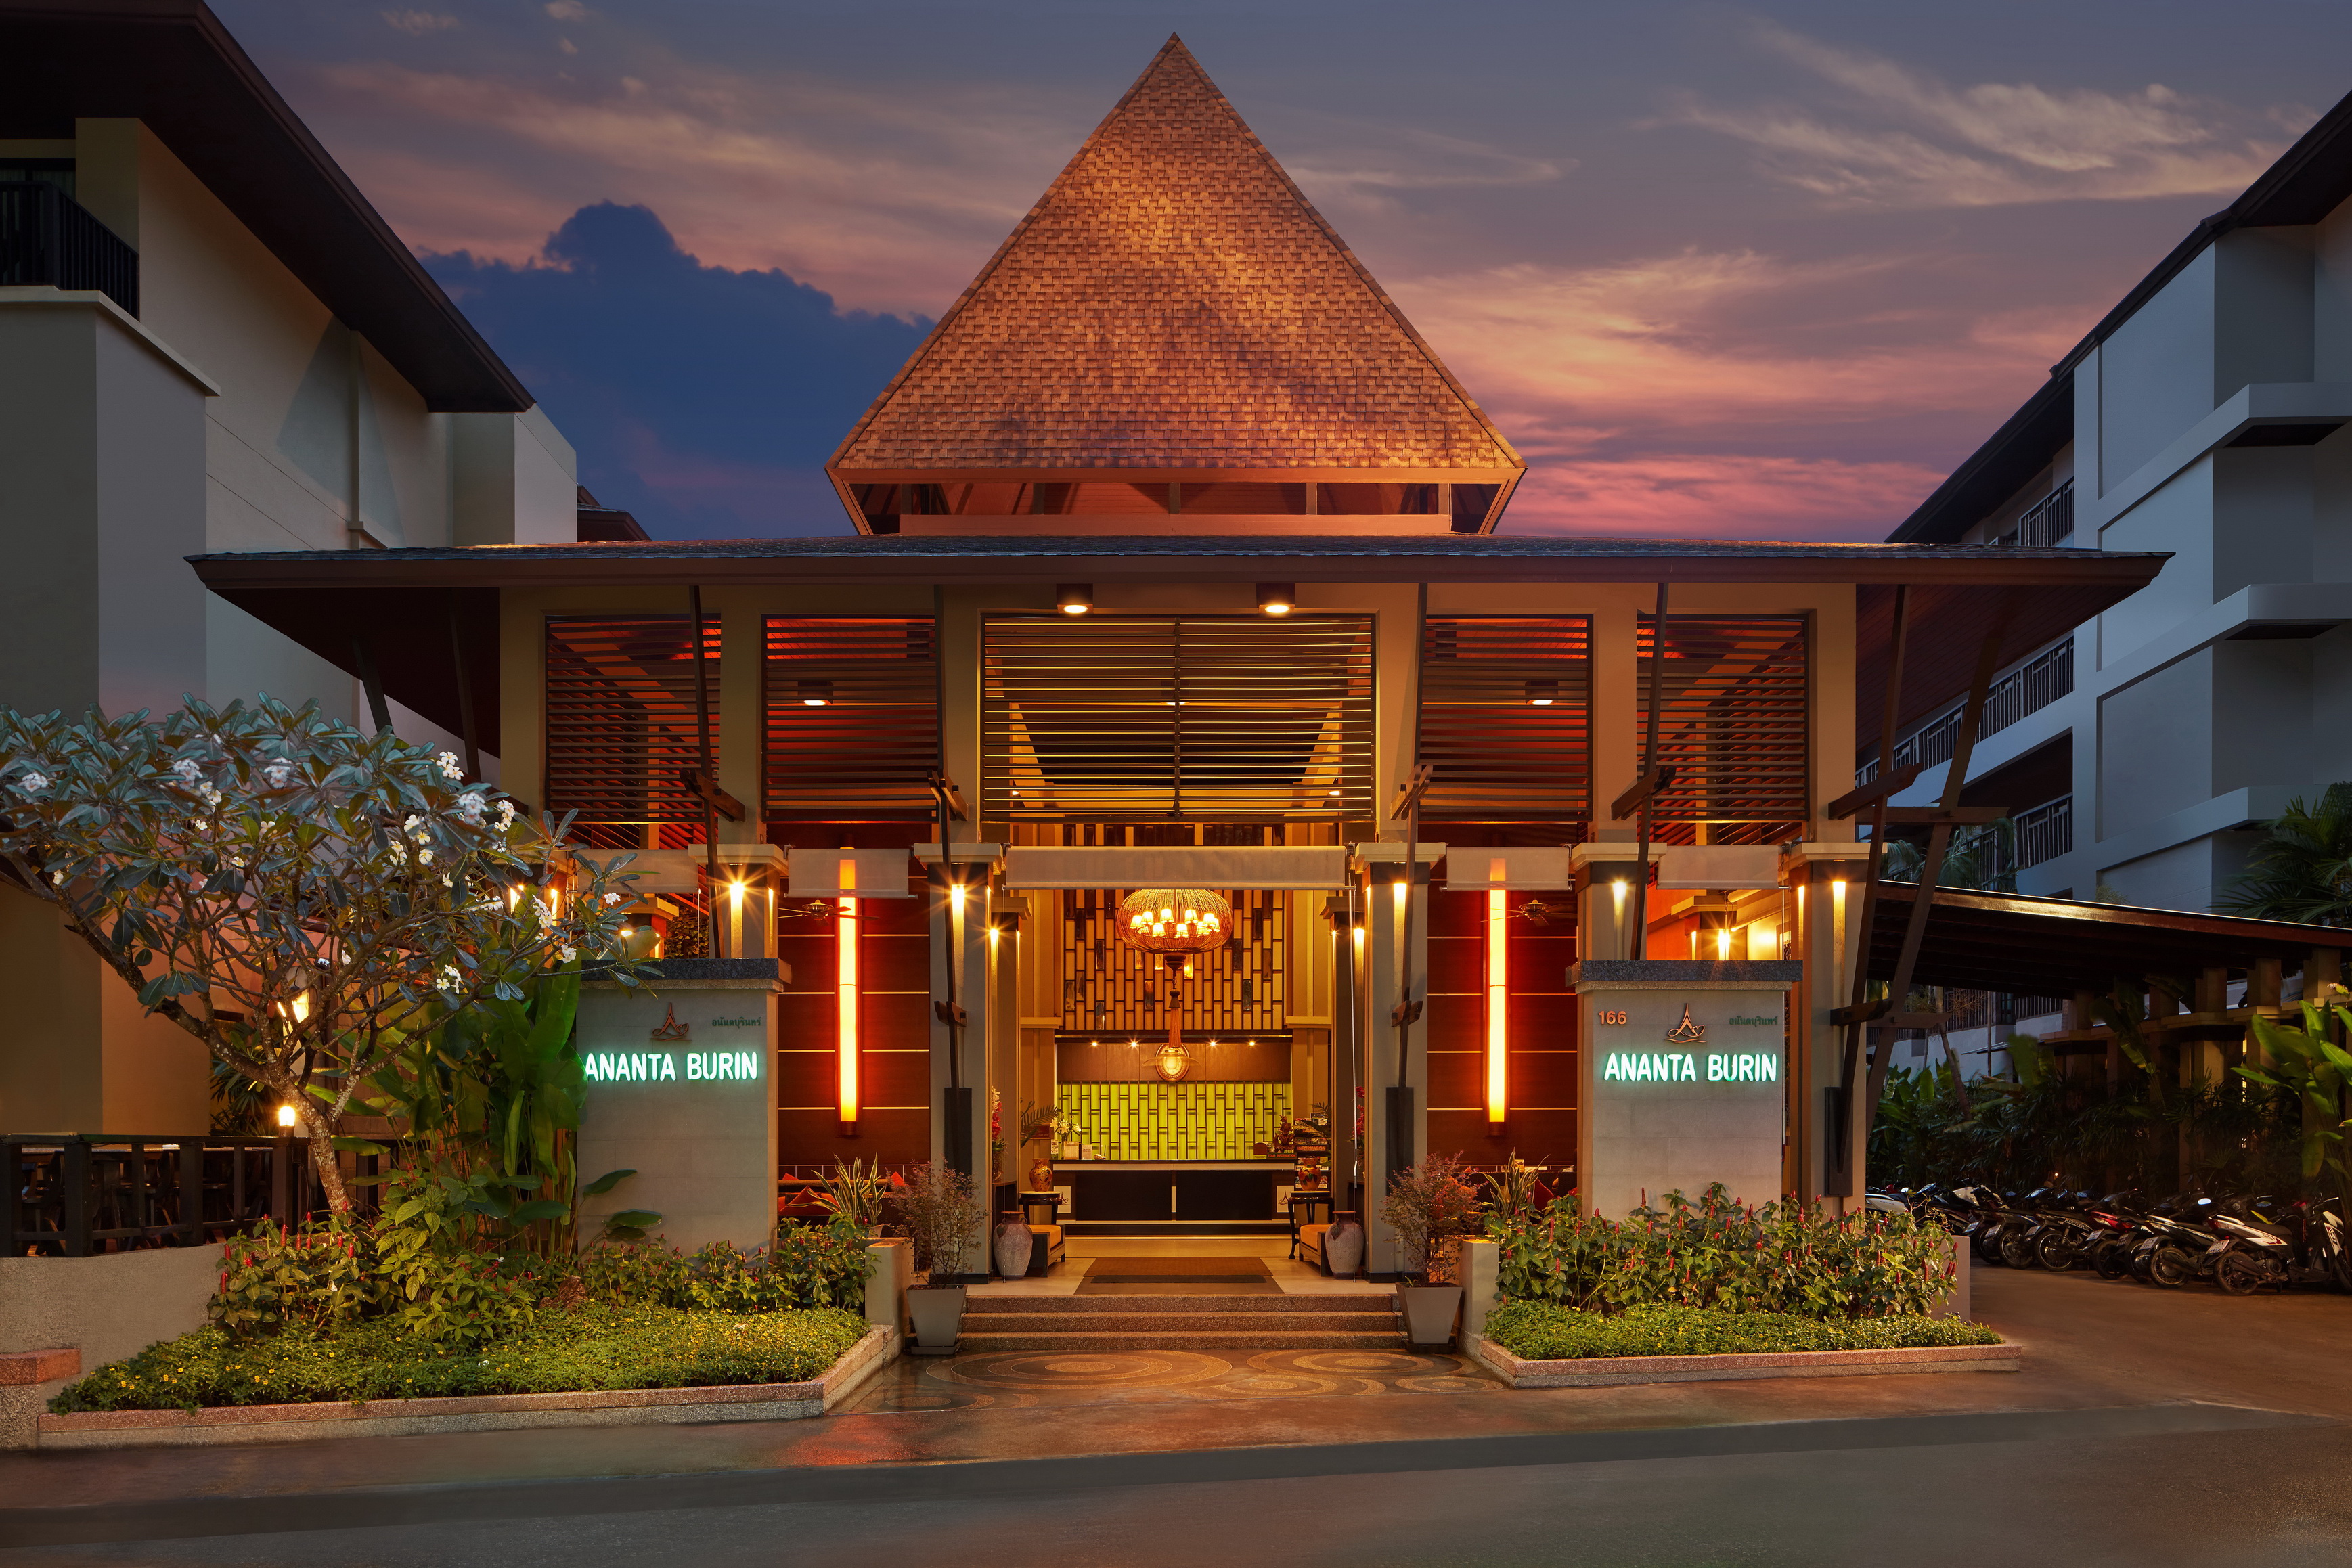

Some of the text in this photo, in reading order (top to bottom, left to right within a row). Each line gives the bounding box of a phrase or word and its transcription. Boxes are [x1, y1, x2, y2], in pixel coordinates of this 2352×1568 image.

[1599, 1010, 1627, 1025] 166
[585, 1052, 757, 1081] ANANTA BURIN
[1604, 1052, 1777, 1081] ANANTA BURIN
